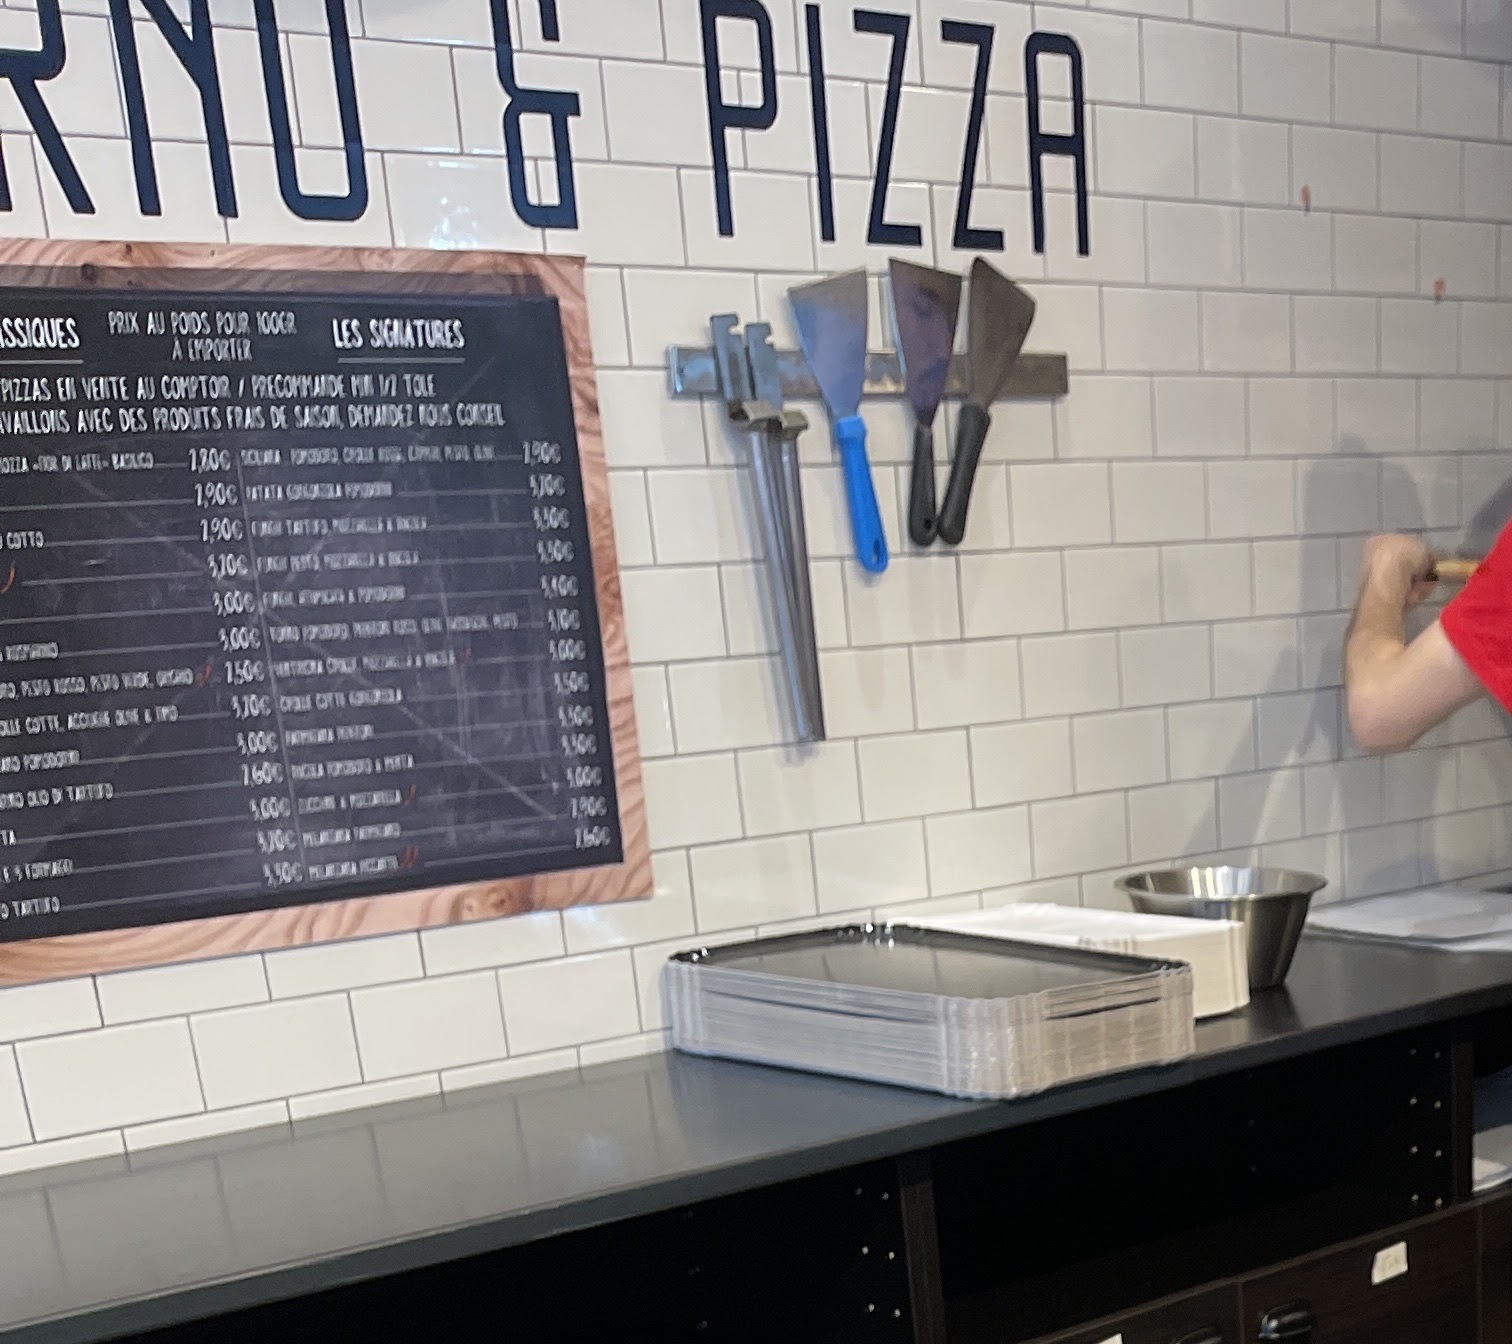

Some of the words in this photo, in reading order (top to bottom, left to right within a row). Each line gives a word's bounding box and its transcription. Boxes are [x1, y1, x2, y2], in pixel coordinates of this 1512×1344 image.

[490, 0, 581, 229] &
[700, 0, 1092, 260] PIZZA
[108, 311, 140, 335] PRIX
[147, 311, 165, 335] AU
[171, 311, 211, 335] POIDS
[215, 311, 249, 335] POUR
[333, 318, 363, 349] LES
[370, 318, 465, 349] SIGNATURES
[188, 338, 252, 361] EMPORTER
[0, 377, 51, 402] PIZZAS
[57, 376, 77, 401] EN
[82, 376, 129, 401] VENTE
[137, 376, 155, 400] AU
[78, 408, 113, 434] AVEC
[119, 407, 147, 433] DES
[153, 406, 221, 432] PRODUITS
[226, 405, 265, 430] FRAIS
[270, 405, 288, 430] DE
[348, 403, 414, 428] DEMANDEZ
